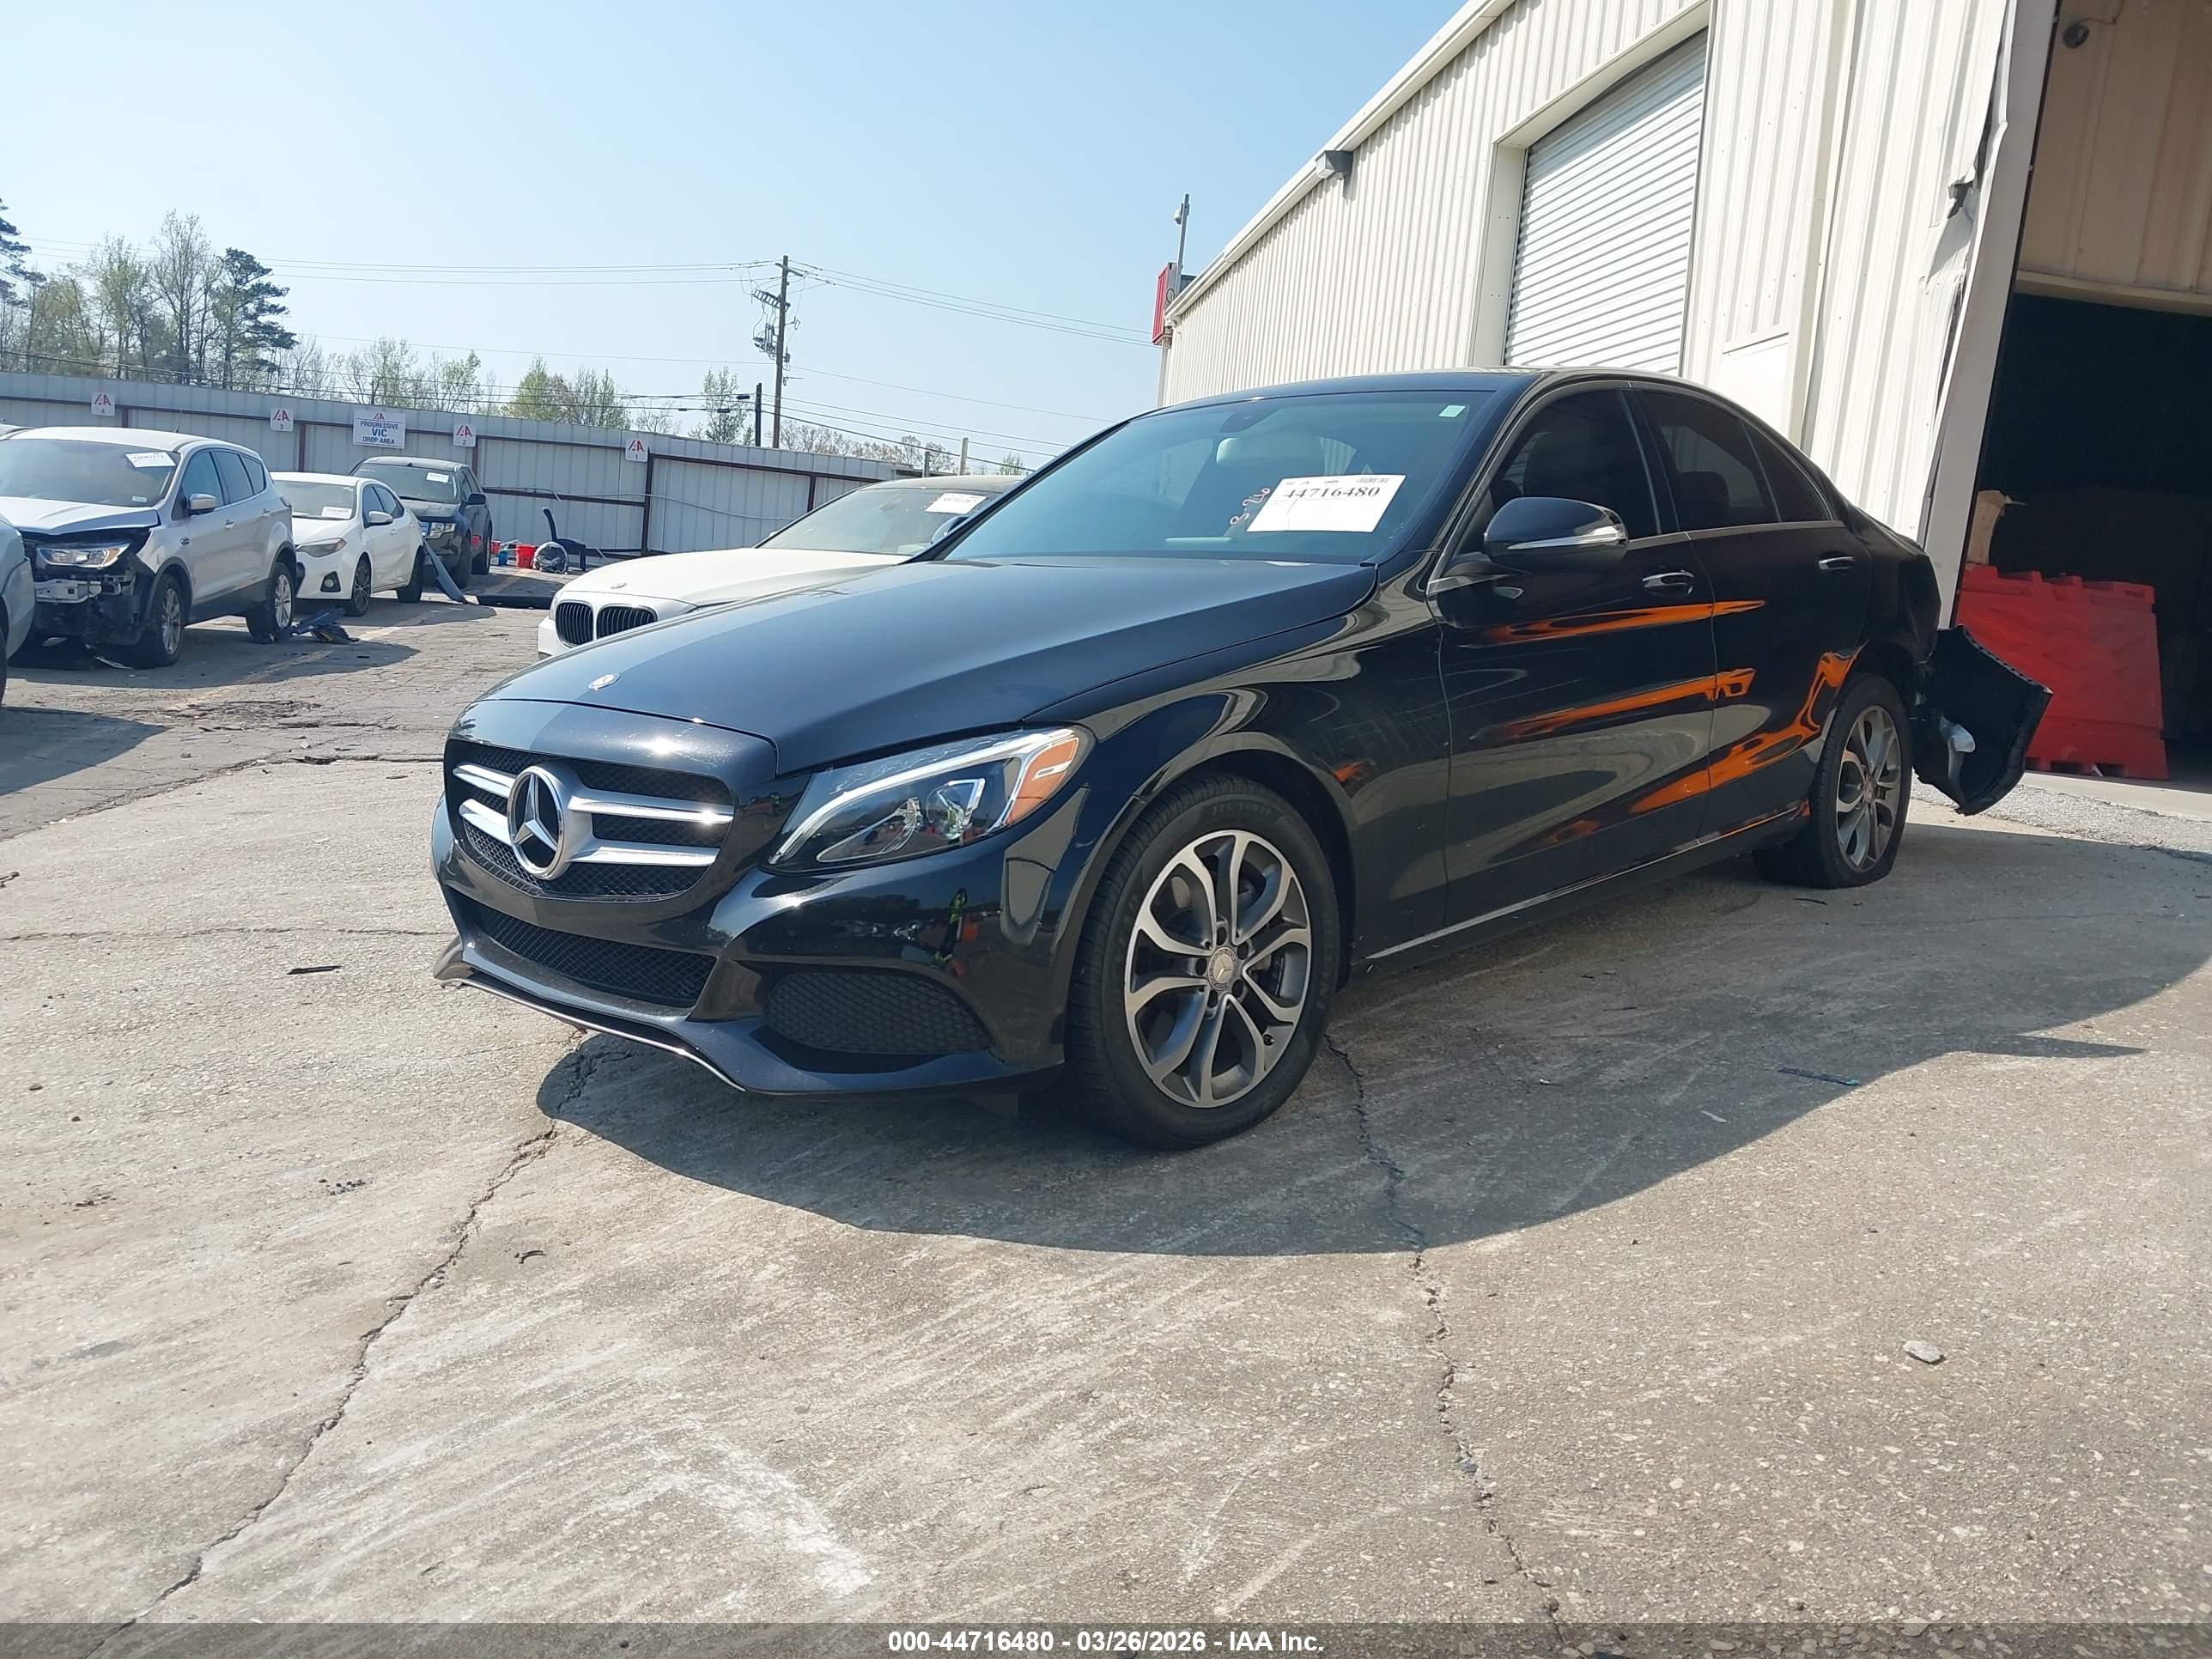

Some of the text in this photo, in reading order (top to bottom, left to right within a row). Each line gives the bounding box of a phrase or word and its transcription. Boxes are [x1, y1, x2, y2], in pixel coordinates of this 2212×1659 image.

[360, 420, 399, 430] PROGRESSIVE
[371, 428, 387, 437] VIC
[1284, 486, 1381, 498] 44716480
